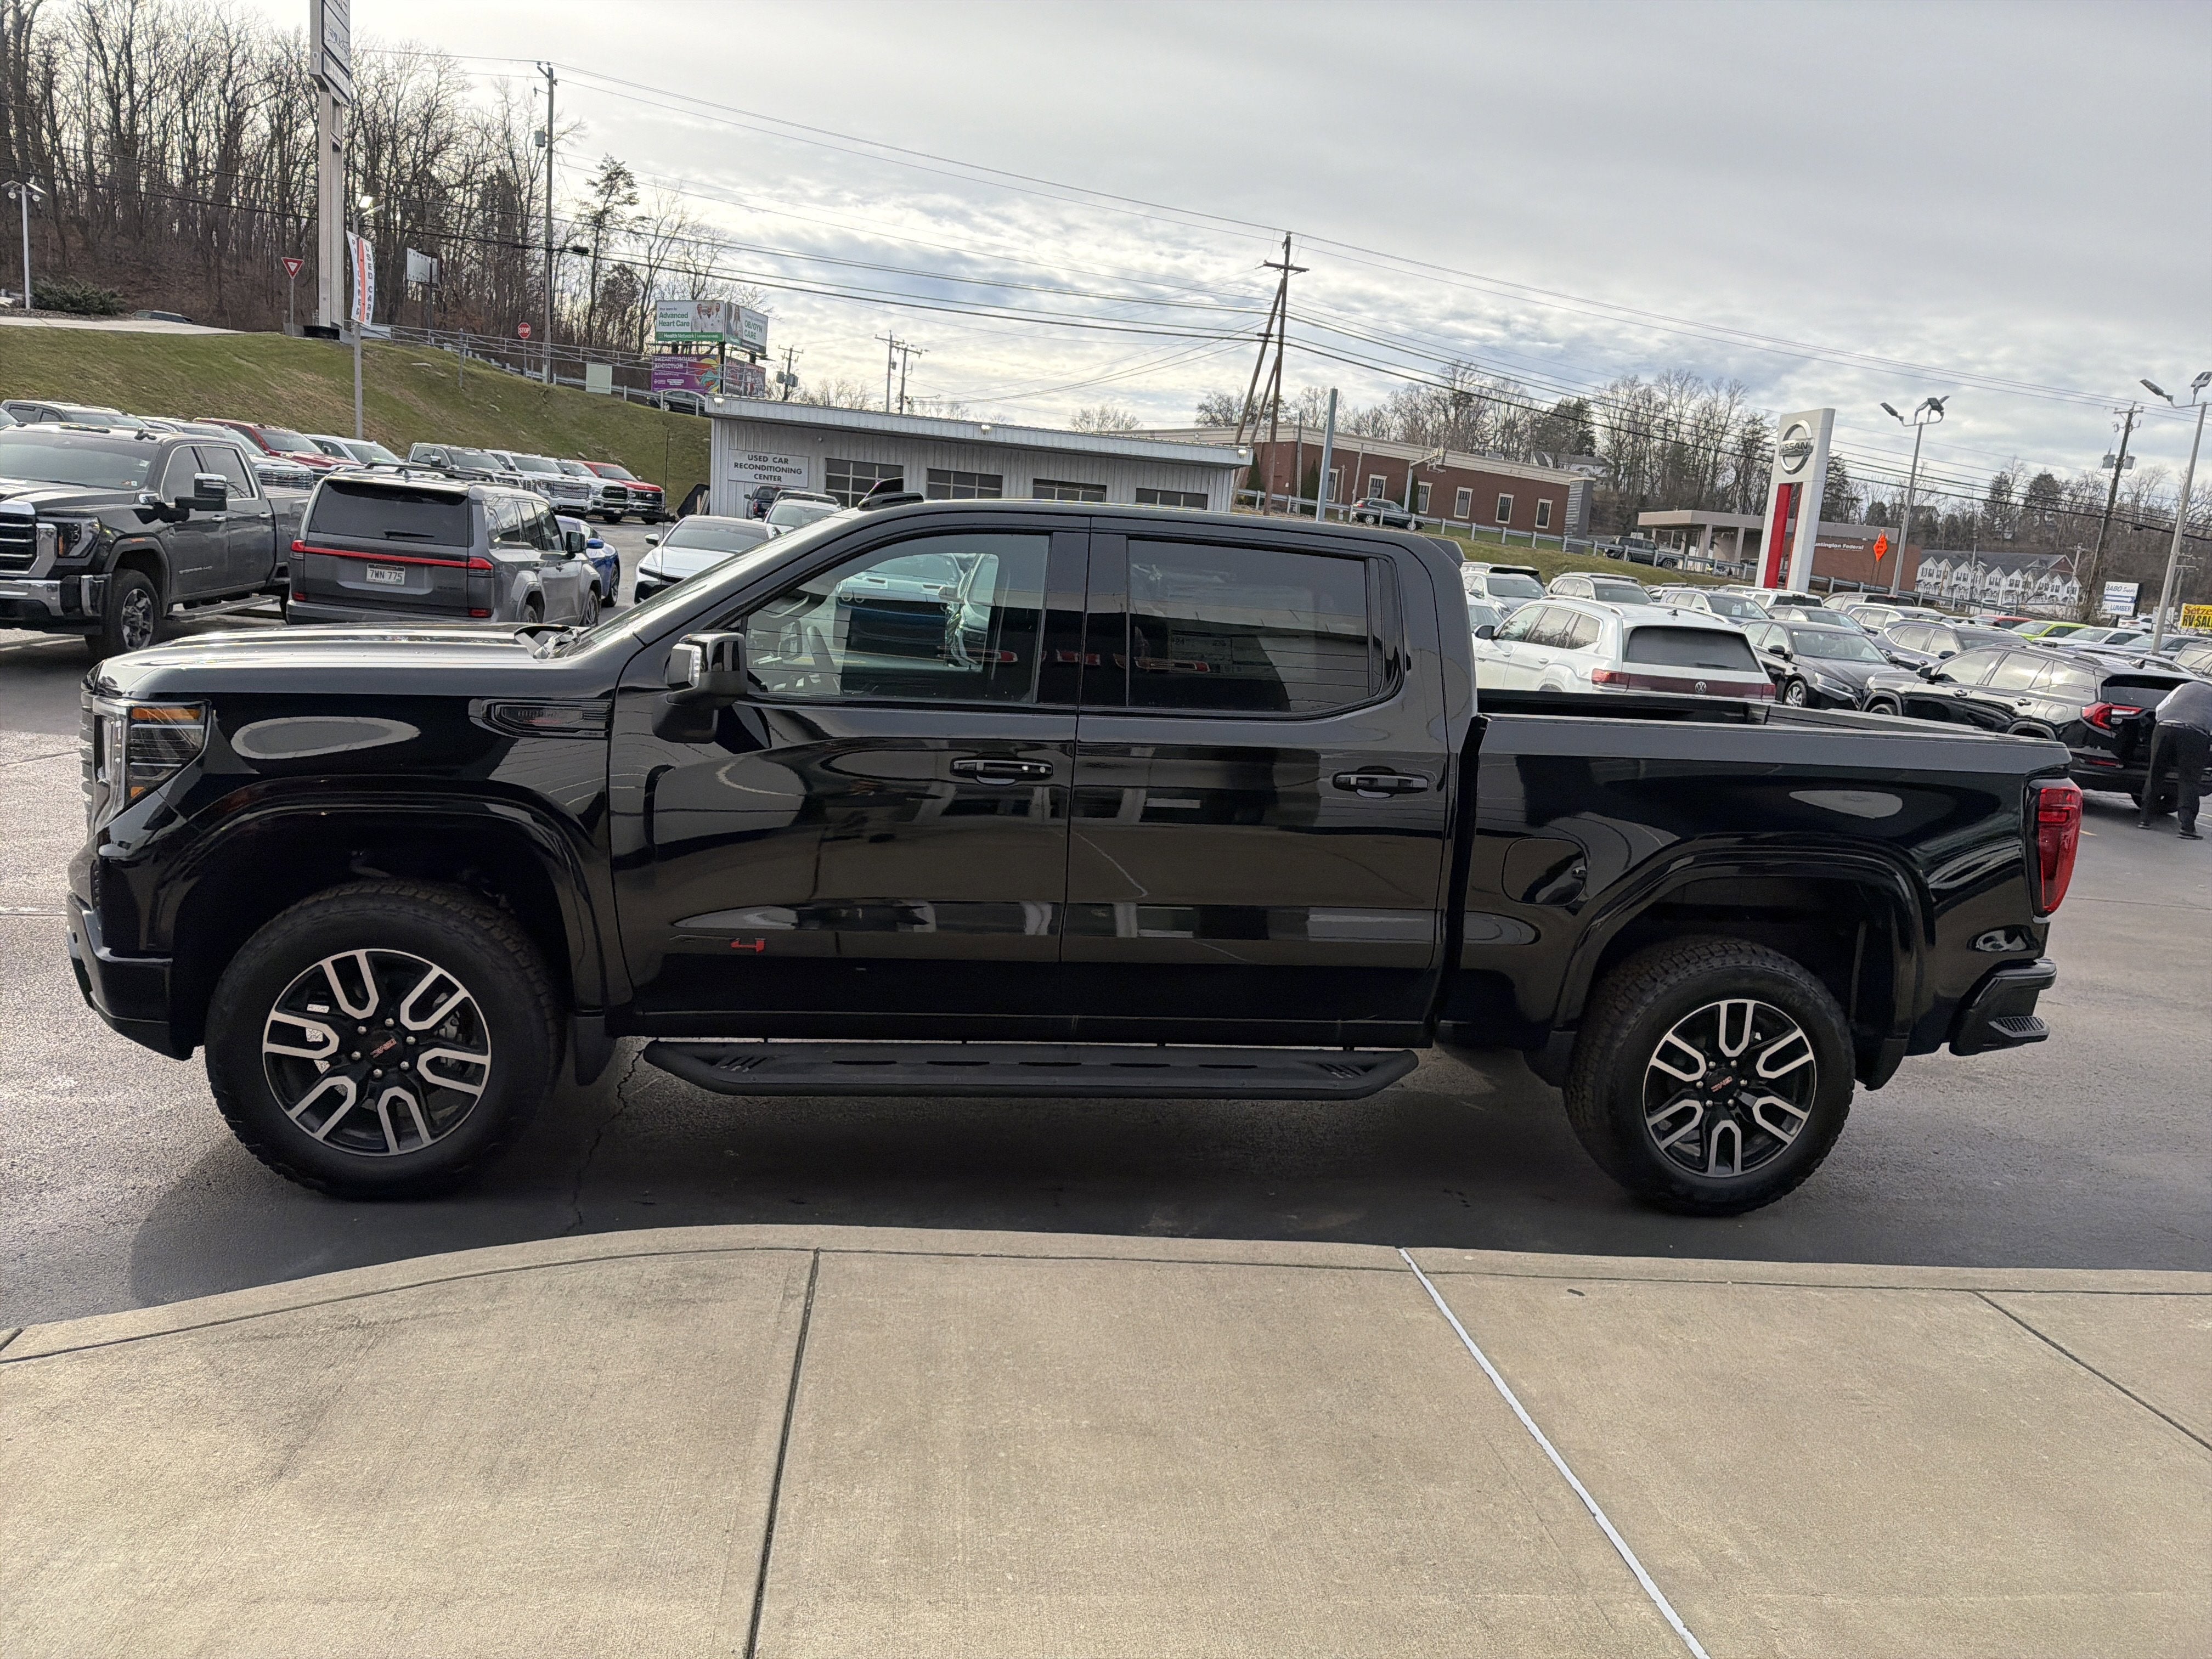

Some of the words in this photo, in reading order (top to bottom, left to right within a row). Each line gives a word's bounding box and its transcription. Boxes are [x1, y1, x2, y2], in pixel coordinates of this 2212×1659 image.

[365, 244, 373, 280] USED
[744, 320, 763, 333] OB/GYN
[744, 329, 757, 340] CARE
[1781, 441, 1808, 452] NISSAN
[772, 456, 789, 465] CAR
[733, 462, 803, 475] RECONDITIONING
[754, 473, 782, 482] CENTER
[369, 569, 385, 579] 7WN
[387, 571, 403, 581] 775
[2182, 614, 2195, 627] RV
[2194, 615, 2212, 628] SAL
